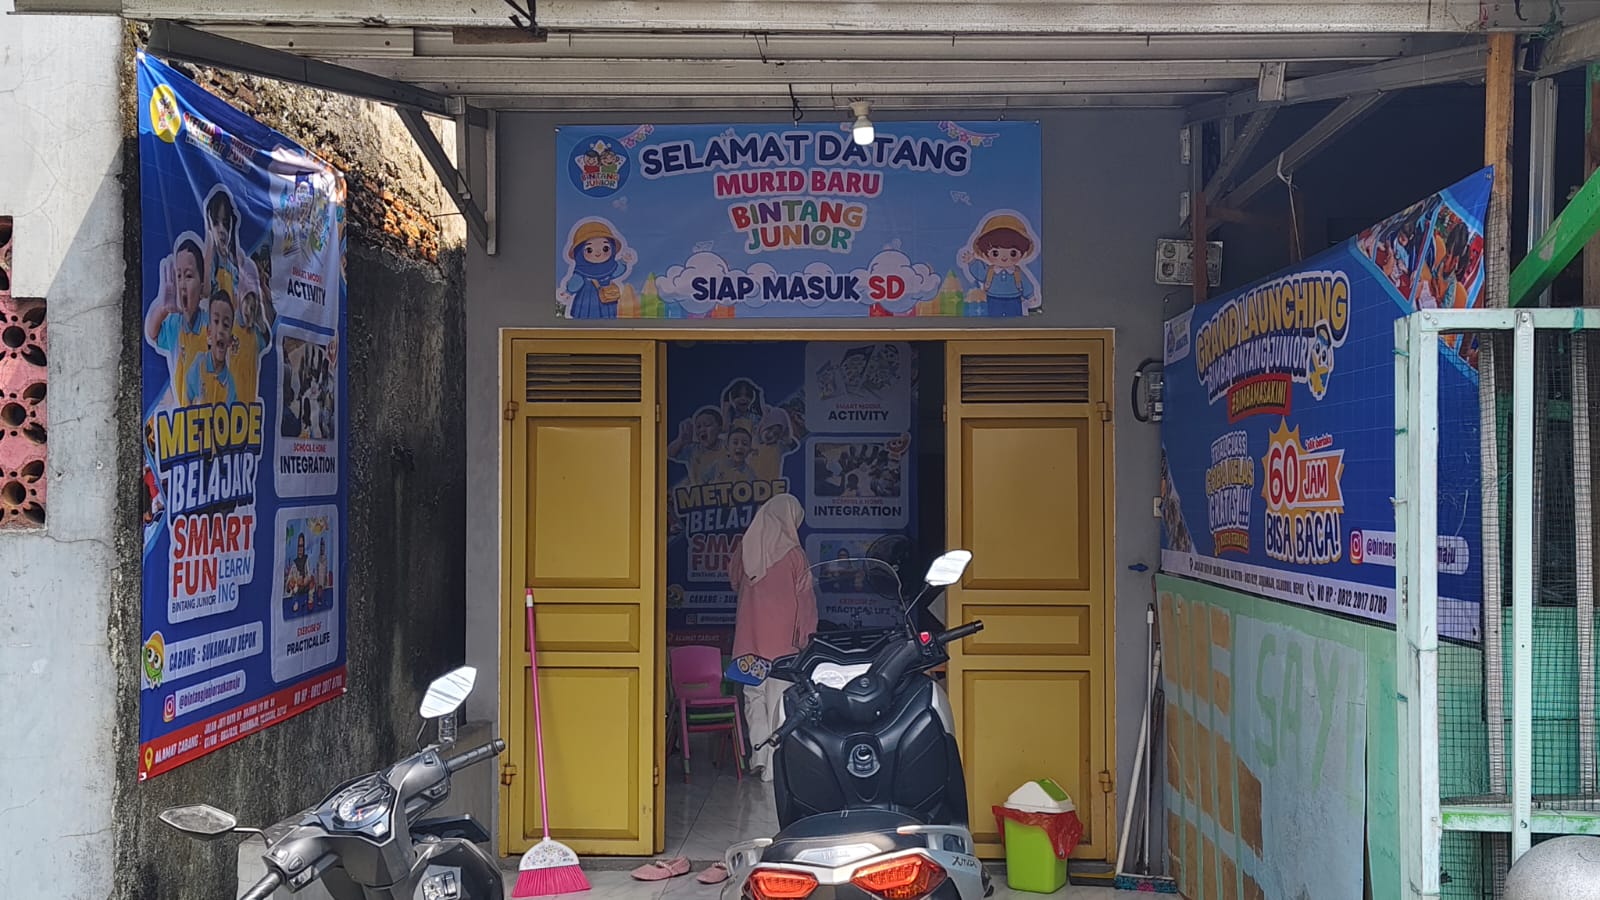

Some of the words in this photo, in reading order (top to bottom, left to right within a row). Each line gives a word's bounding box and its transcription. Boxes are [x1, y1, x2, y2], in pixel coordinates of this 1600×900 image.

[642, 133, 810, 175] SELAMAT
[819, 134, 968, 172] DATANG
[716, 171, 804, 196] MURID
[811, 170, 880, 194] BARU
[731, 201, 864, 229] BINTANG
[749, 225, 851, 250] JUNIOR
[287, 278, 326, 306] ACTIVITY
[692, 275, 754, 301] SIAP
[763, 274, 860, 301] MASUK
[869, 276, 906, 301] SD
[1197, 306, 1239, 374] GRAND
[1239, 280, 1347, 343] LAUNCHING
[1232, 338, 1267, 378] BINTANG
[1270, 335, 1308, 369] JUNIOR
[828, 410, 889, 421] ACTIVITY
[158, 405, 261, 460] METODE
[1227, 432, 1247, 458] CLASS
[280, 455, 336, 474] INTEGRATION
[1269, 444, 1298, 504] 60
[1303, 462, 1328, 496] JAM
[172, 454, 255, 514] BELAJAR
[676, 479, 786, 510] METODE
[690, 505, 755, 532] BELAJ
[814, 505, 902, 516] INTEGRATION
[1210, 487, 1238, 530] GRATIS
[173, 515, 253, 559] SMART
[1266, 512, 1293, 557] BISA
[1296, 511, 1340, 559] BACA!
[173, 557, 218, 597] FUN
[219, 557, 251, 579] LEARN
[172, 599, 196, 614] BINTANG
[196, 595, 217, 608] JUNIOR
[218, 583, 236, 604] ING
[1317, 584, 1325, 601] NO
[1326, 585, 1333, 603] HP
[1337, 588, 1352, 608] 0812
[1353, 590, 1369, 611] 2017
[1369, 593, 1388, 615] 0708
[169, 647, 196, 673] CABANG
[202, 636, 237, 662] SUKAMAJU
[237, 631, 257, 652] DEPOK
[287, 634, 319, 656] PRACTICAL
[319, 631, 330, 646] LIFE
[155, 743, 177, 764] ALAMAT
[178, 734, 199, 755] CABANG
